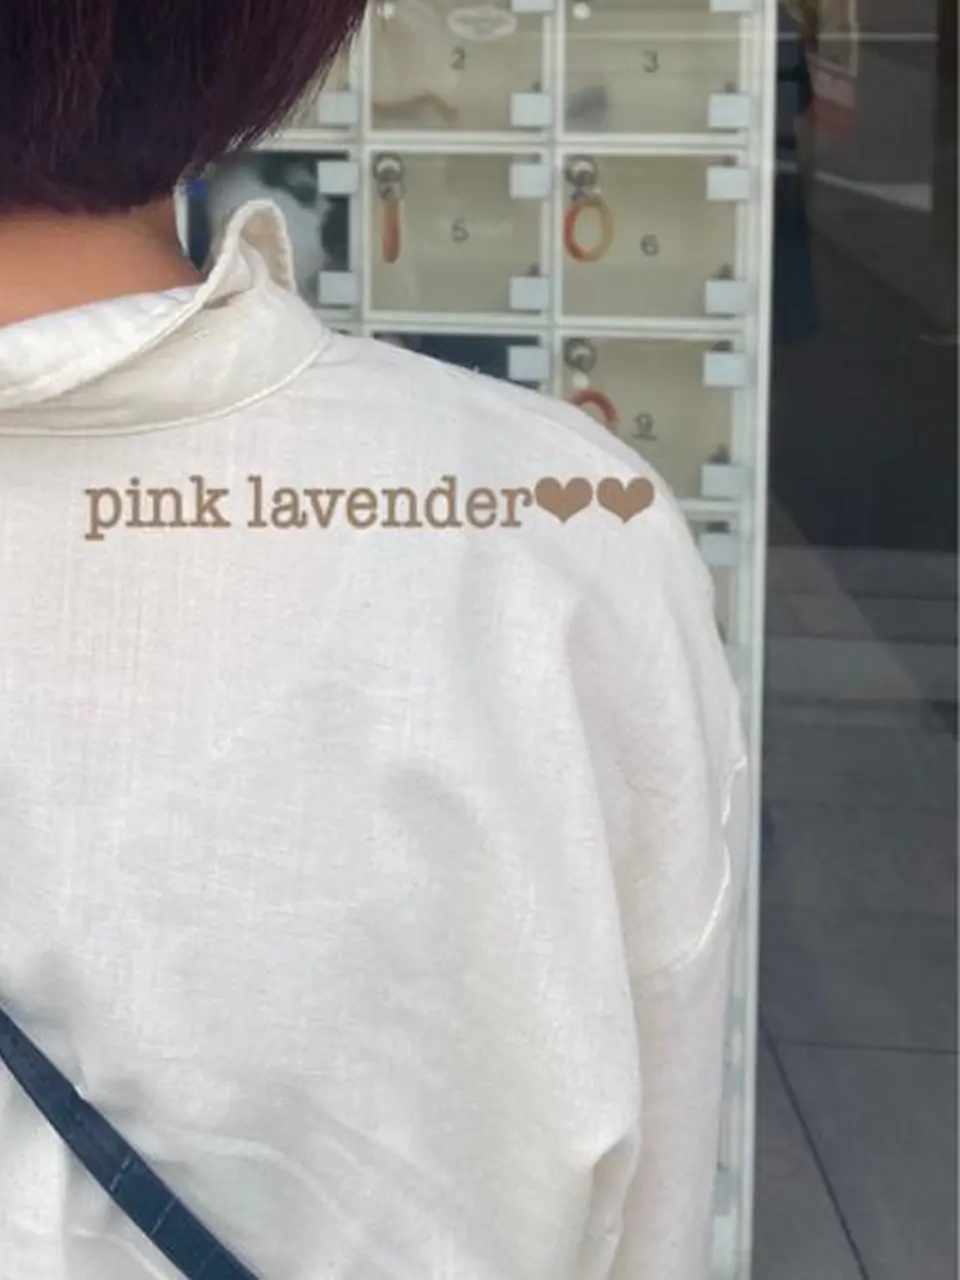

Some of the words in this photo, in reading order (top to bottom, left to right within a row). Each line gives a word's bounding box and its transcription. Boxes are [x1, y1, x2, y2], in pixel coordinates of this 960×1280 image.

[451, 46, 466, 70] 2
[643, 49, 659, 73] 3
[451, 220, 469, 243] 5
[640, 234, 659, 257] 6
